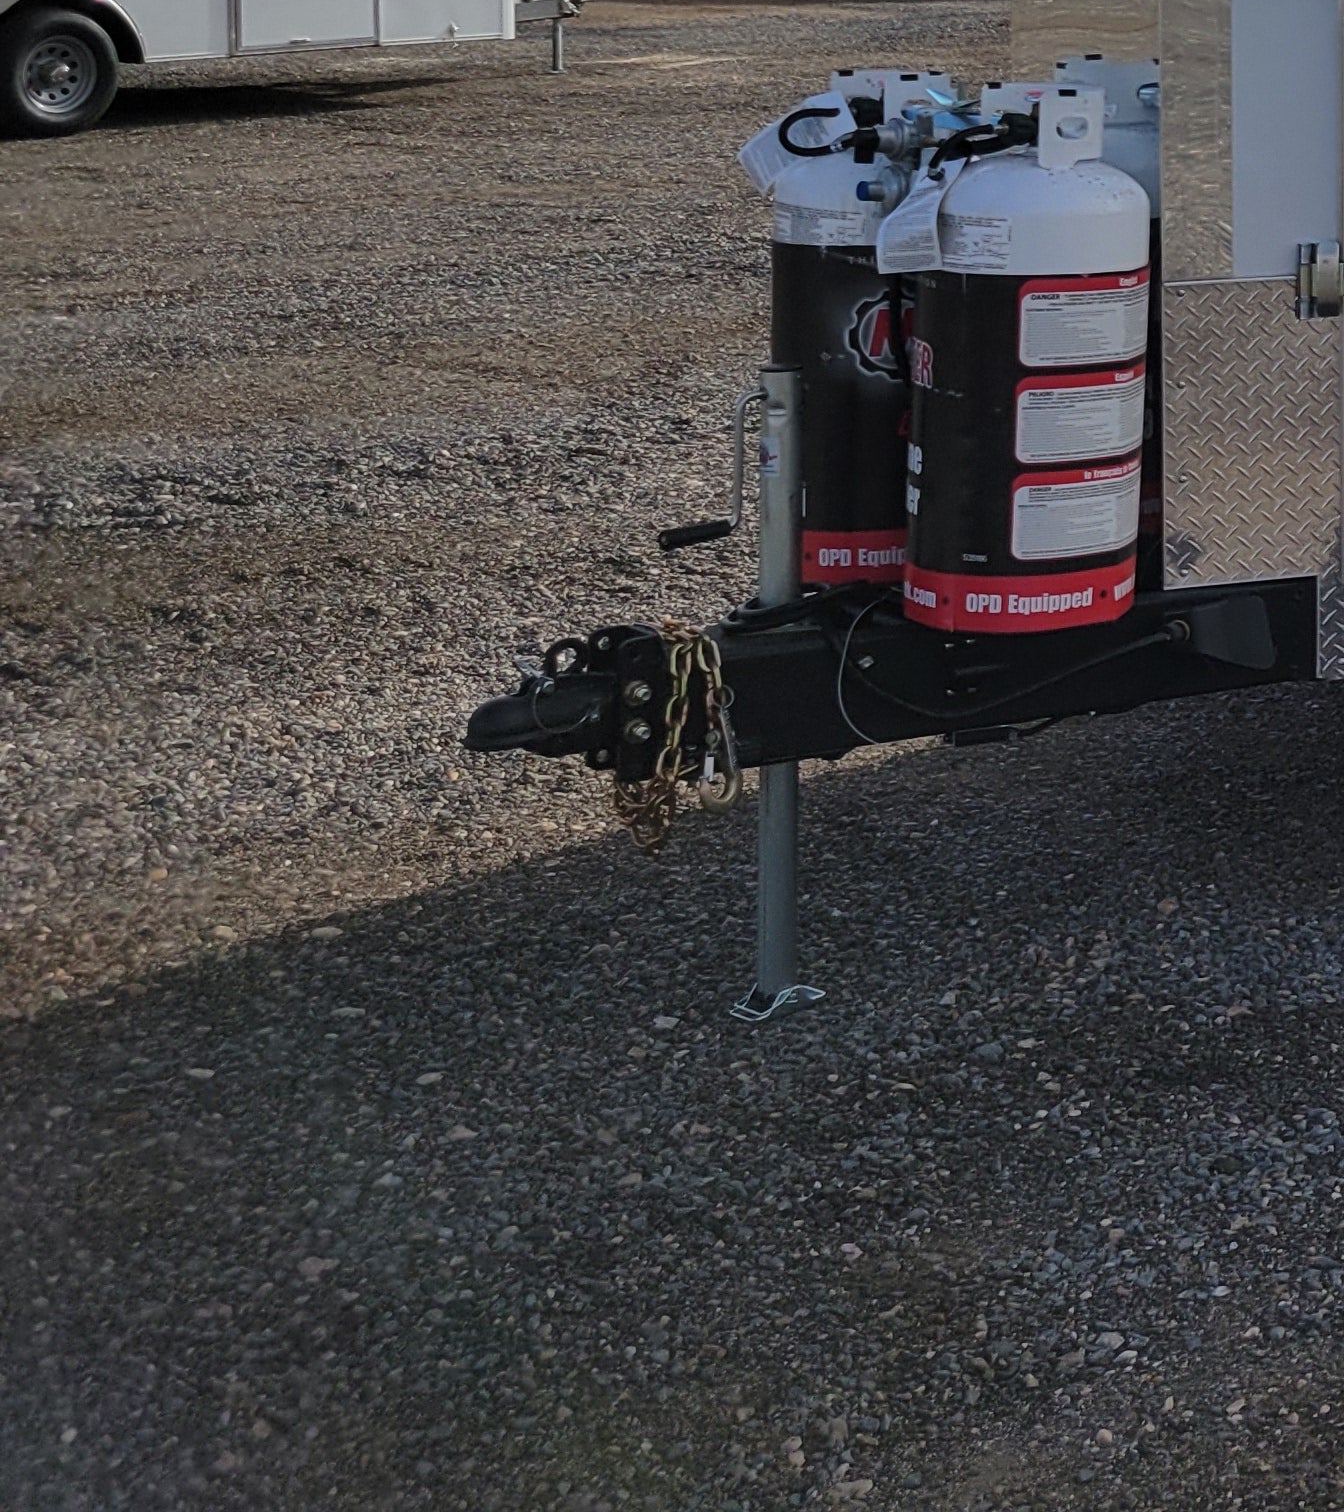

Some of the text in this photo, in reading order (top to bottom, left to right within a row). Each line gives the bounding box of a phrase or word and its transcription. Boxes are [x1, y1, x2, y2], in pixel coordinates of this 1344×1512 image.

[818, 548, 851, 567] OPD
[966, 586, 1094, 616] OPD Equipped
